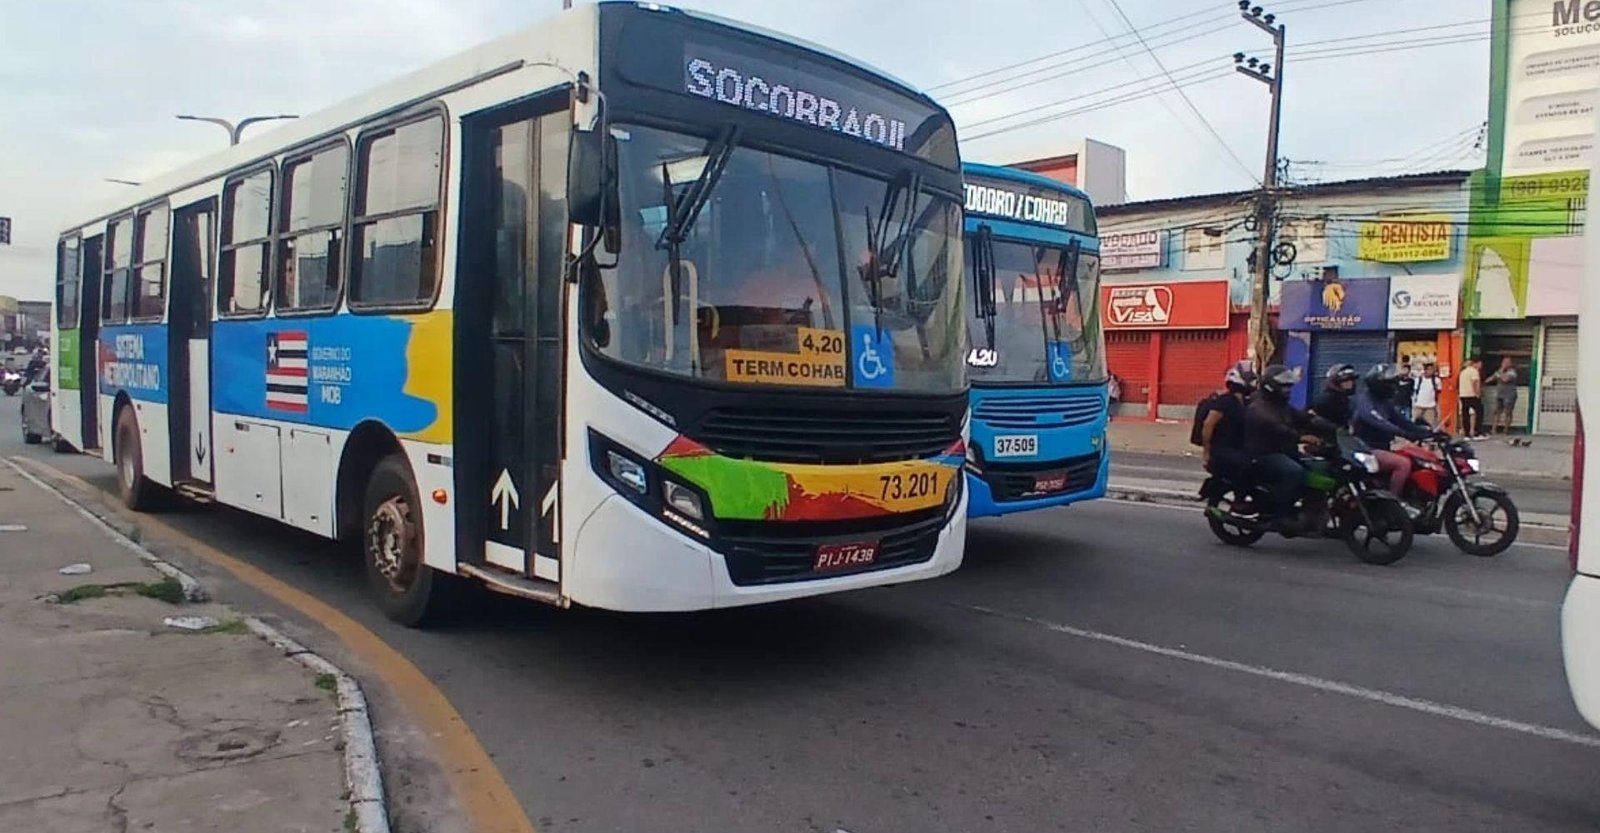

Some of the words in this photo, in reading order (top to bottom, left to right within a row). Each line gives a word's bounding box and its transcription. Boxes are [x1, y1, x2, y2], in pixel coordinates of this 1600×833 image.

[1381, 223, 1447, 245] DENTISTA
[116, 333, 145, 359] SISTEMA
[802, 333, 843, 355] 4,20
[104, 361, 160, 391] METROPOLITANO
[732, 358, 784, 376] TERM
[787, 362, 844, 379] COHAB
[321, 385, 342, 405] MOB
[880, 471, 938, 501] 73.201
